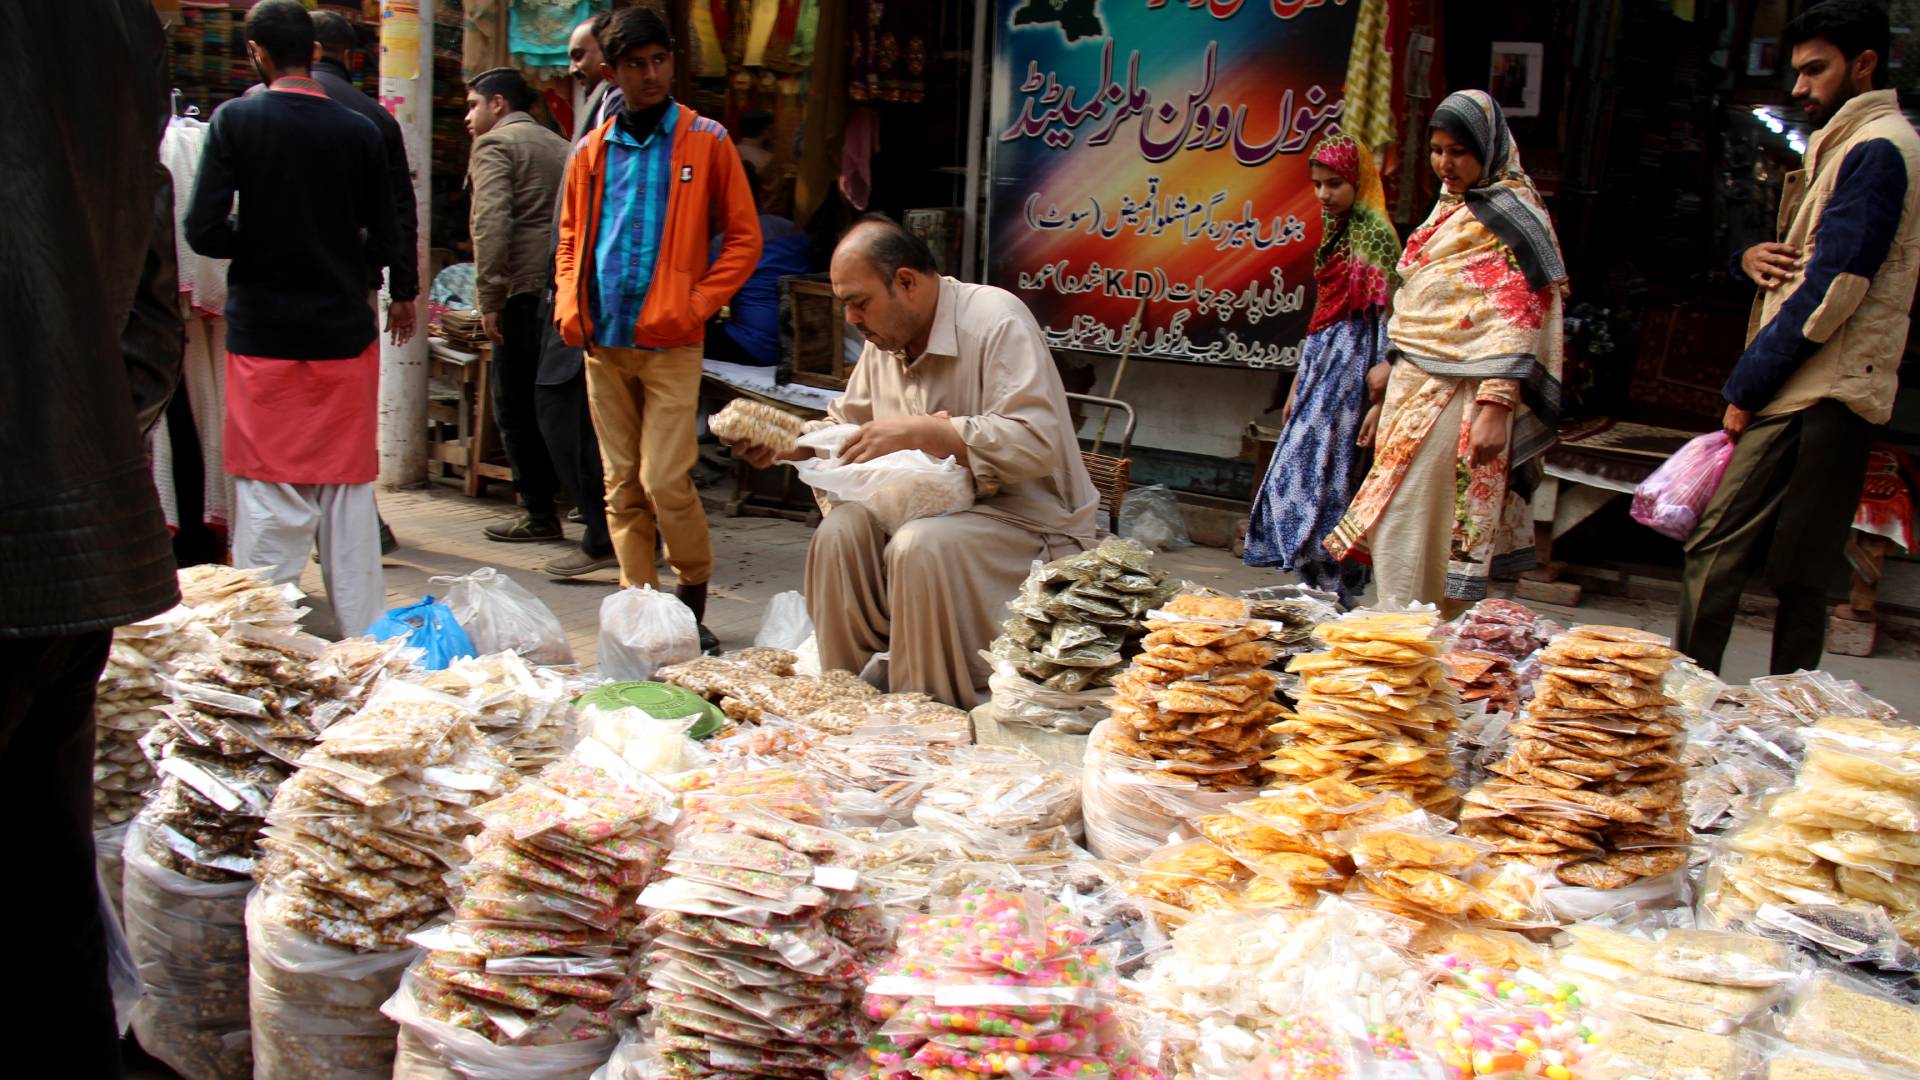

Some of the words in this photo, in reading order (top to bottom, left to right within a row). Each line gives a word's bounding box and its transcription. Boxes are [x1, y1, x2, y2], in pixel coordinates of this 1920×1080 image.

[999, 36, 1115, 148] لمیٹڈ
[1086, 48, 1151, 145] ملز
[1138, 39, 1234, 162] وولن
[1231, 84, 1346, 165] بنوں
[1135, 194, 1190, 236] شلوار
[1183, 189, 1228, 245] گرم
[1253, 215, 1306, 250] بنوں
[1018, 263, 1056, 290] عمدہ
[1262, 265, 1305, 317] اونی
